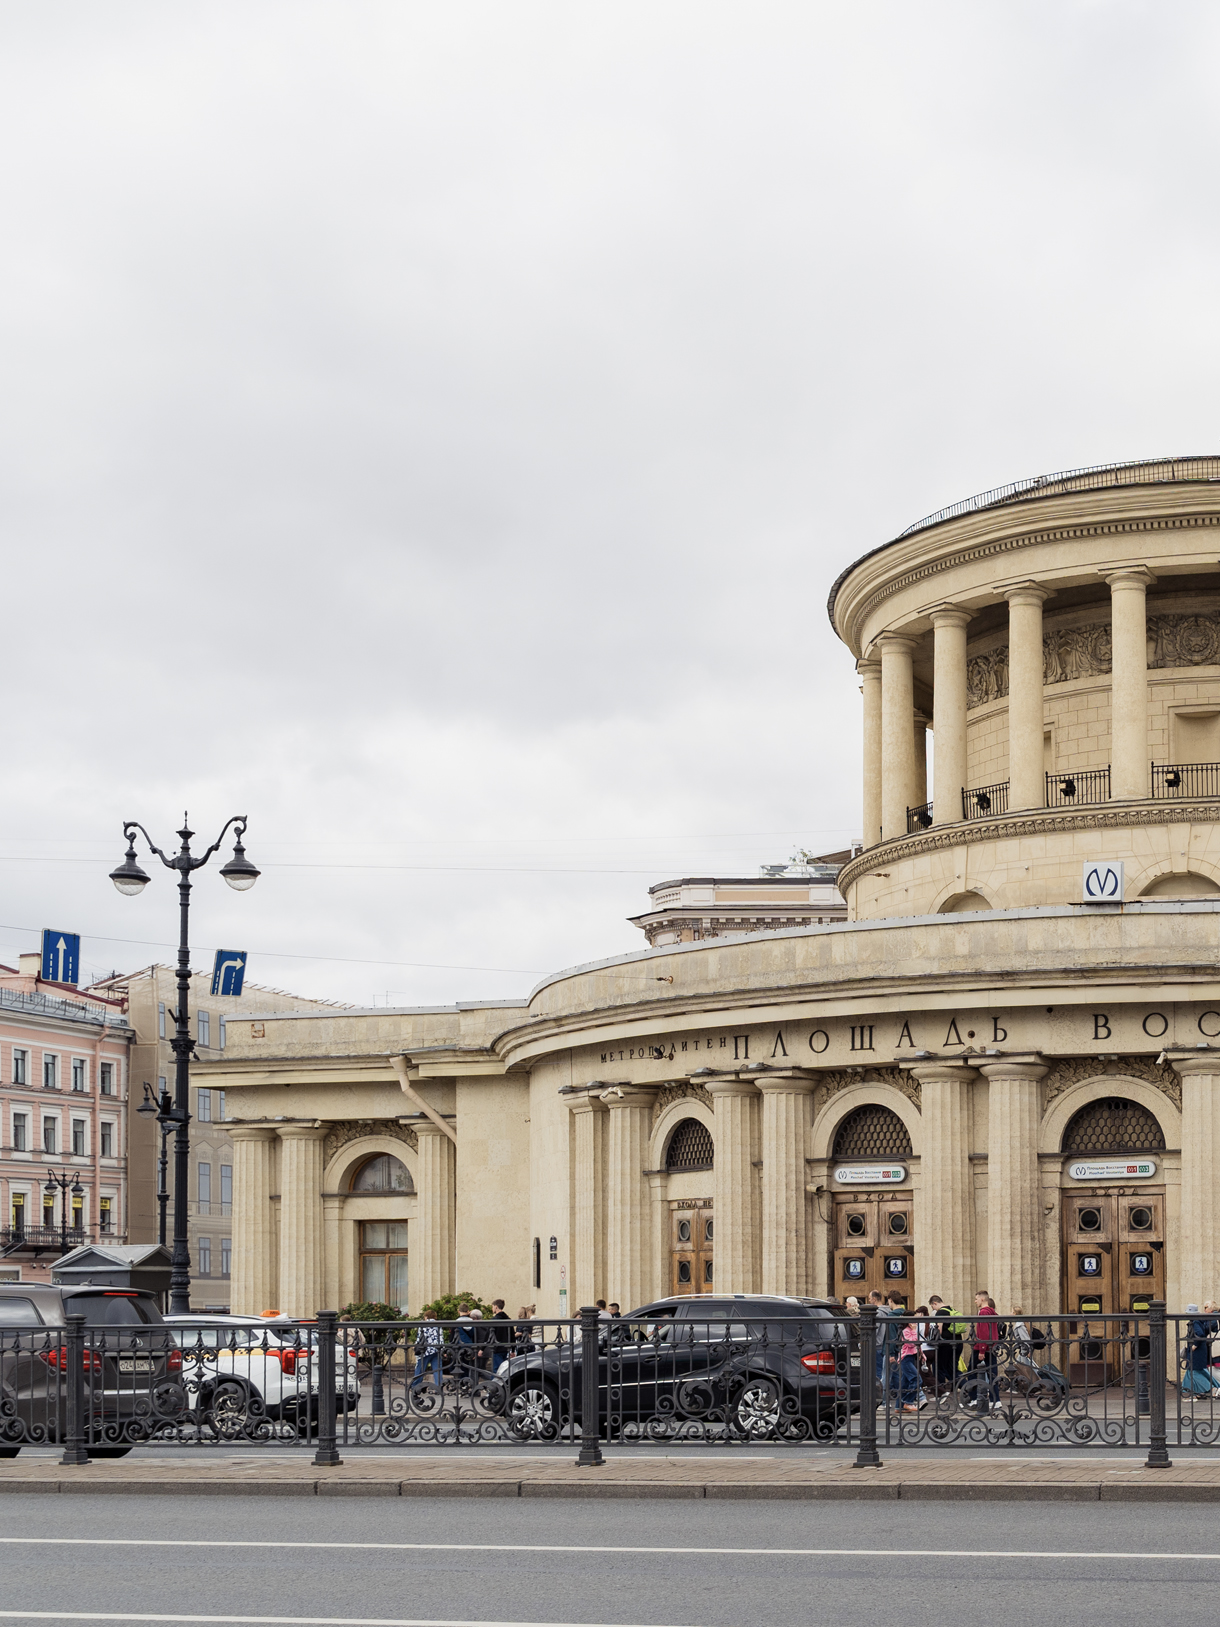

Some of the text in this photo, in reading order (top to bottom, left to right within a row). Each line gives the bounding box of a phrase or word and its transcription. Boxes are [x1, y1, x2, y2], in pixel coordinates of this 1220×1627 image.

[733, 1015, 1009, 1061] ПЛОЩАДЬ
[600, 1036, 727, 1064] МЕТРОПОЛИТЕН
[853, 1192, 898, 1201] ВХОД
[1091, 1187, 1139, 1196] ВХОД
